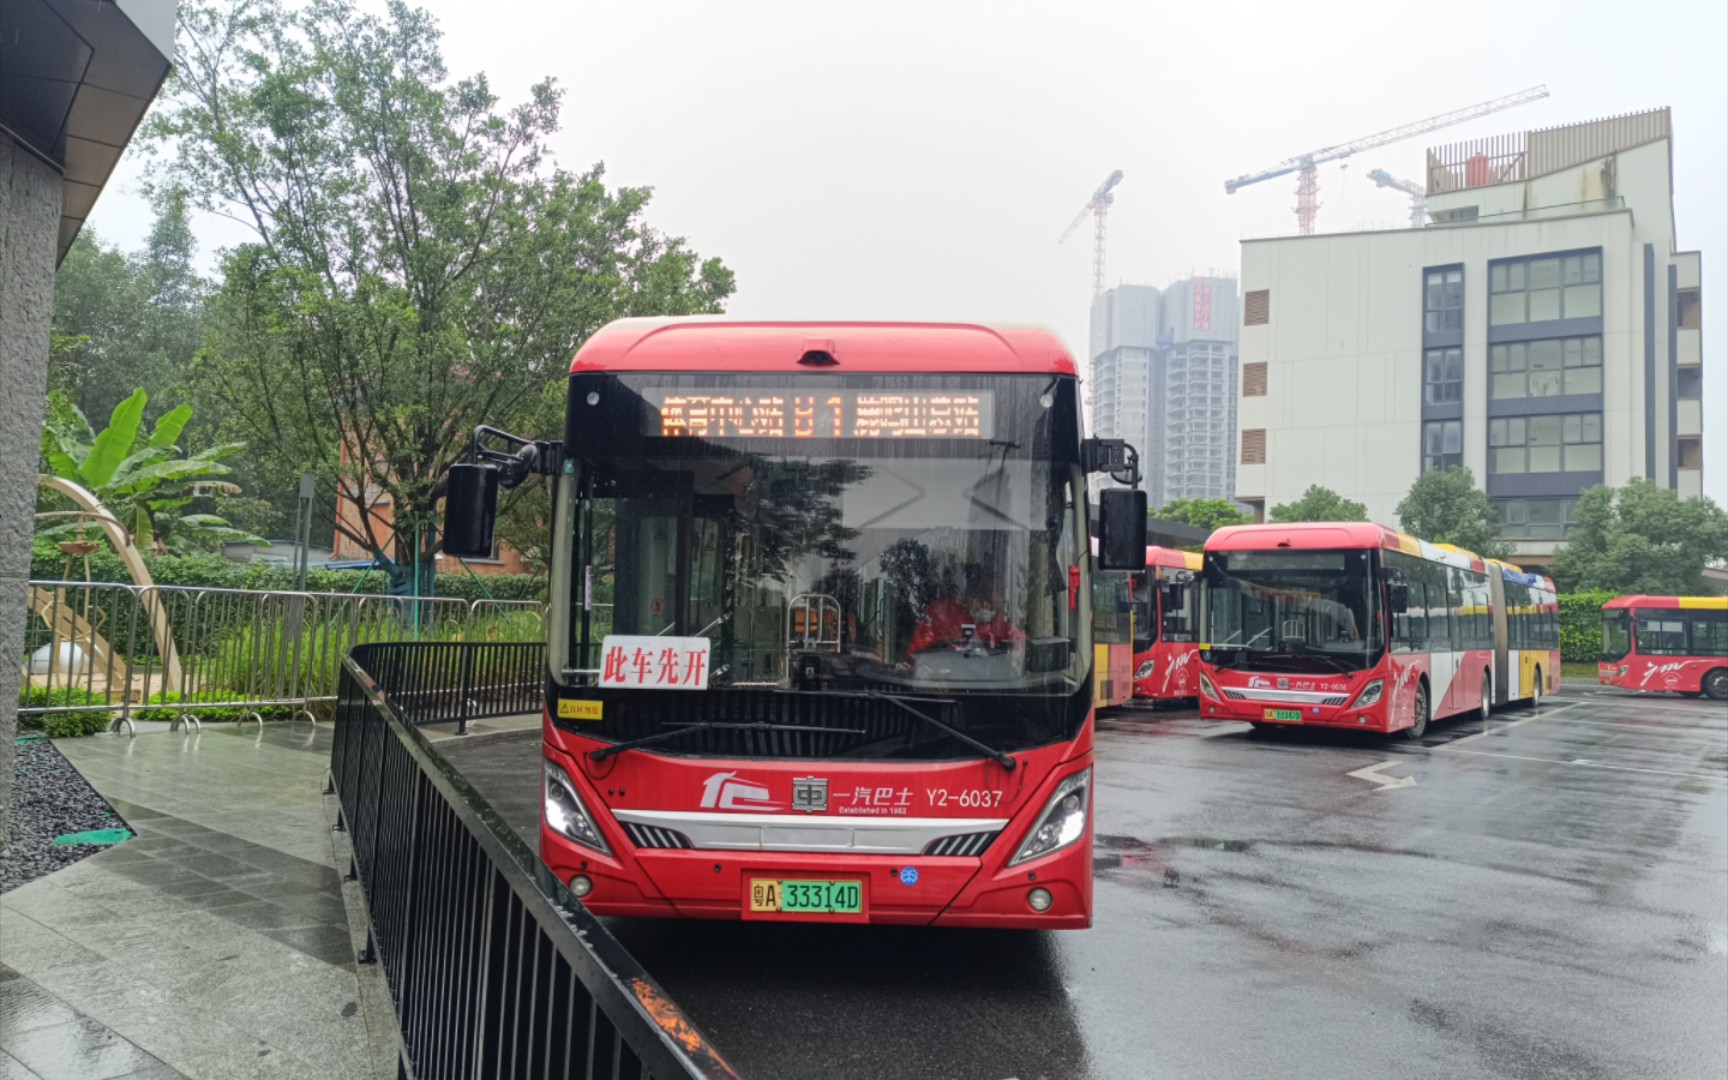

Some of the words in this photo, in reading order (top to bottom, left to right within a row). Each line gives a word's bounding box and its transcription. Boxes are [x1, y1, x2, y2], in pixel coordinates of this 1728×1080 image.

[603, 646, 706, 686] 此车先开
[832, 787, 914, 805] 一汽巴士
[926, 789, 1003, 808] Y2-6037
[839, 806, 880, 815] Established
